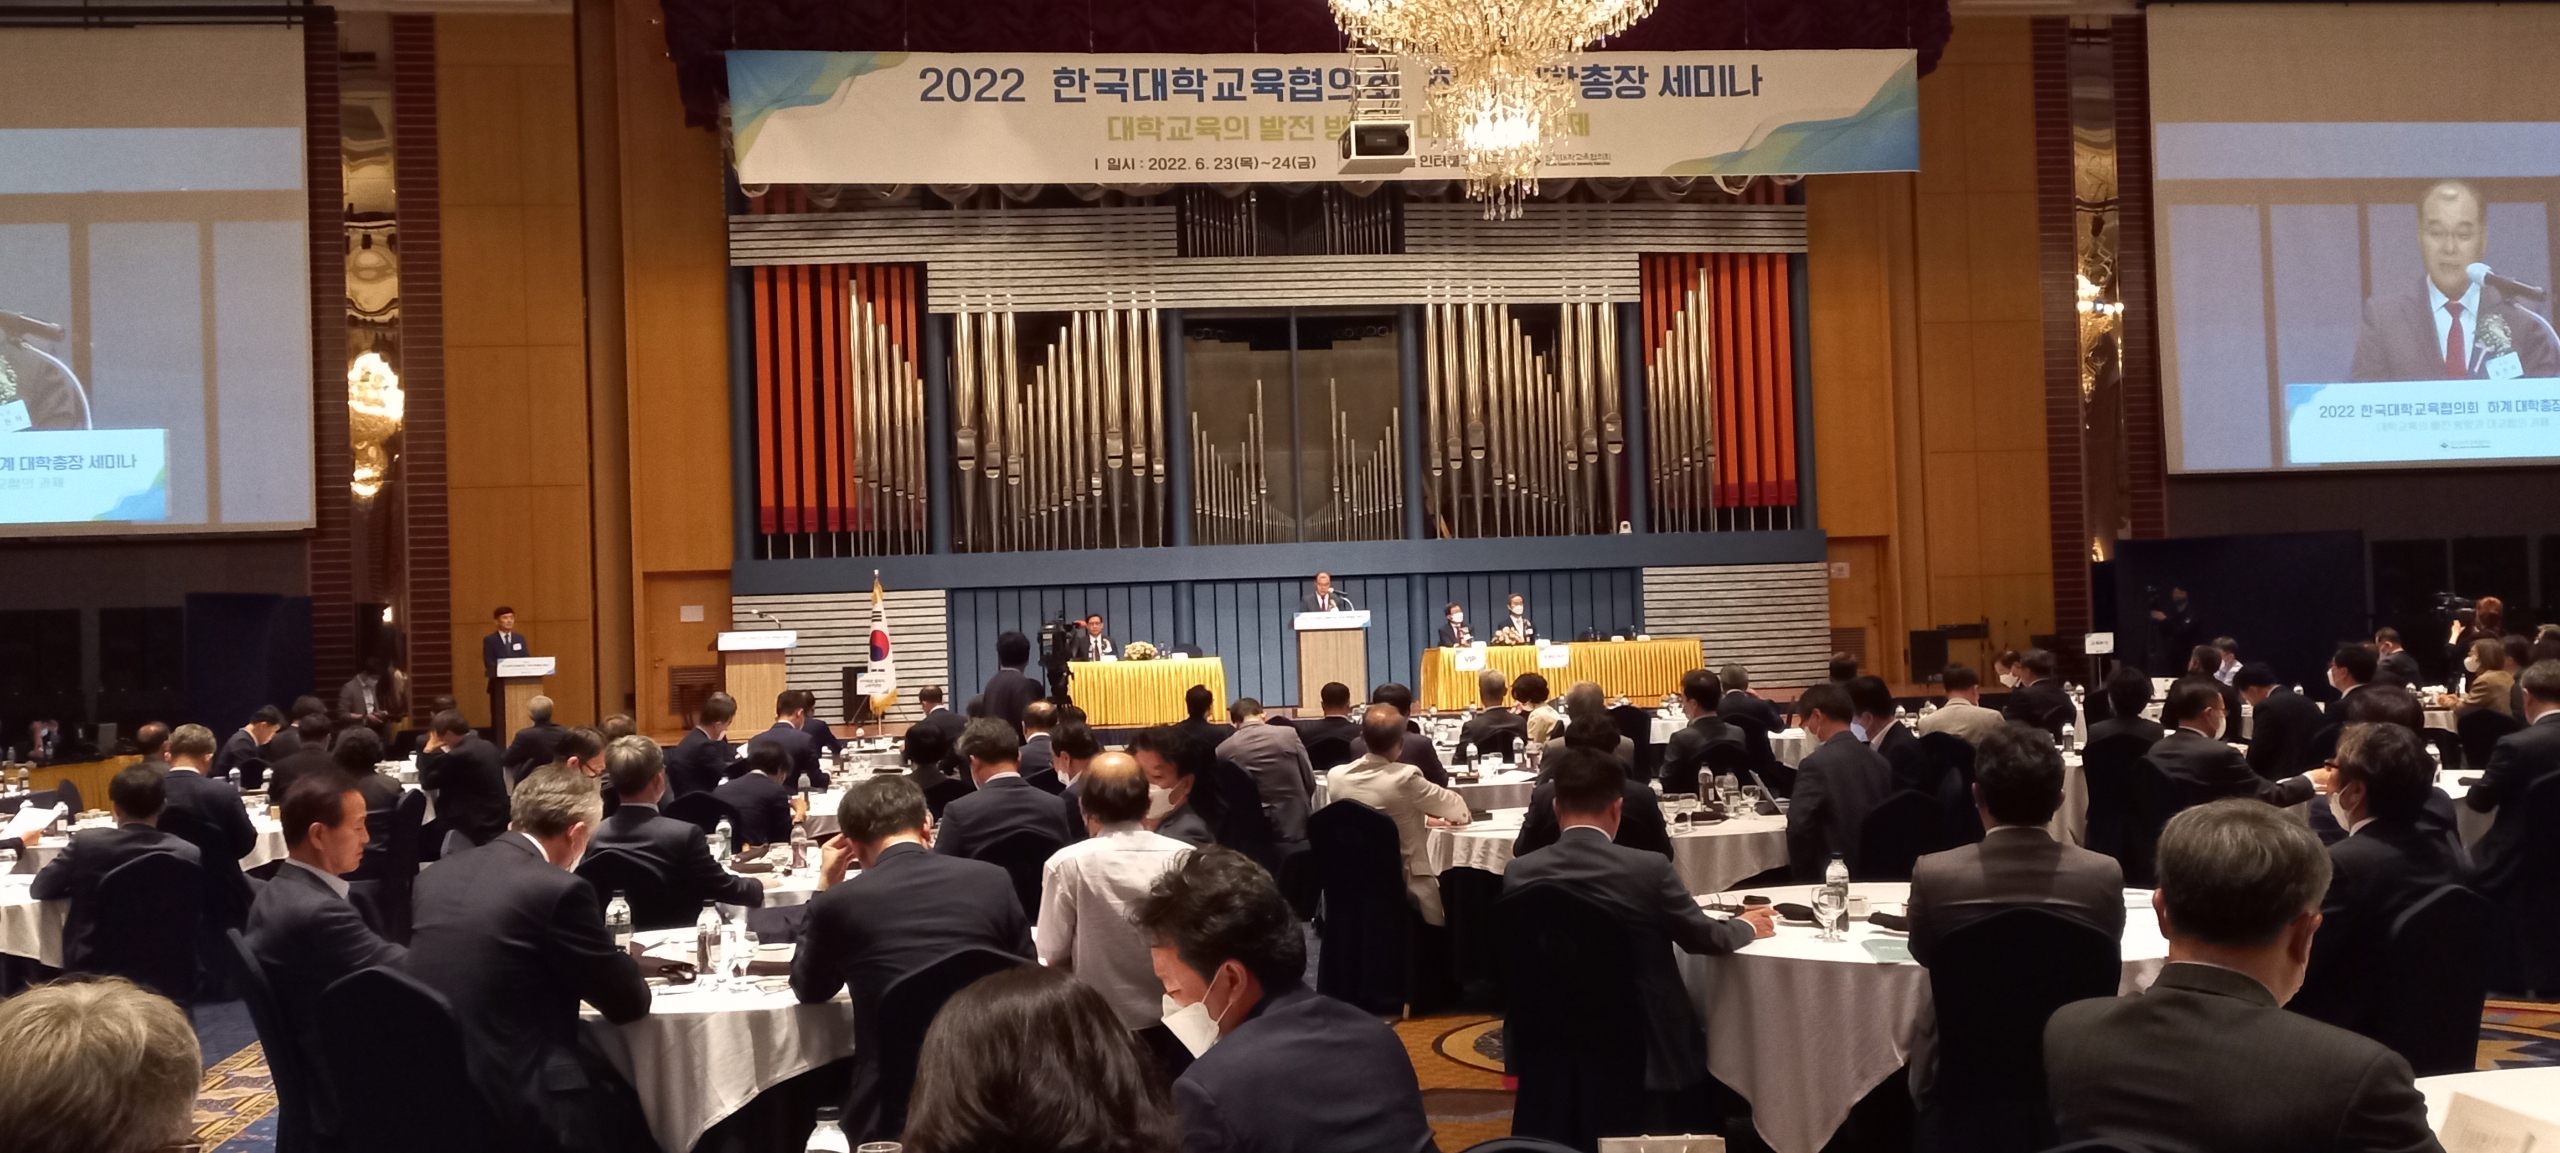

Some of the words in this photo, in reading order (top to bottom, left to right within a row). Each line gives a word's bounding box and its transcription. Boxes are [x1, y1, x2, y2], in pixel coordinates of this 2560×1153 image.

[919, 67, 1026, 102] 2022
[1659, 64, 1762, 98] 세미나
[1107, 115, 1249, 142] 대학교육의
[1259, 115, 1315, 142] 발전
[1107, 157, 1135, 171] 일시
[1148, 157, 1192, 171] 2022.
[2319, 404, 2355, 419] 2022
[2360, 401, 2479, 418] 한국대학교육협의회
[2487, 400, 2512, 414] 하계
[20, 455, 84, 471] 대학총장
[88, 453, 138, 469] 세미나
